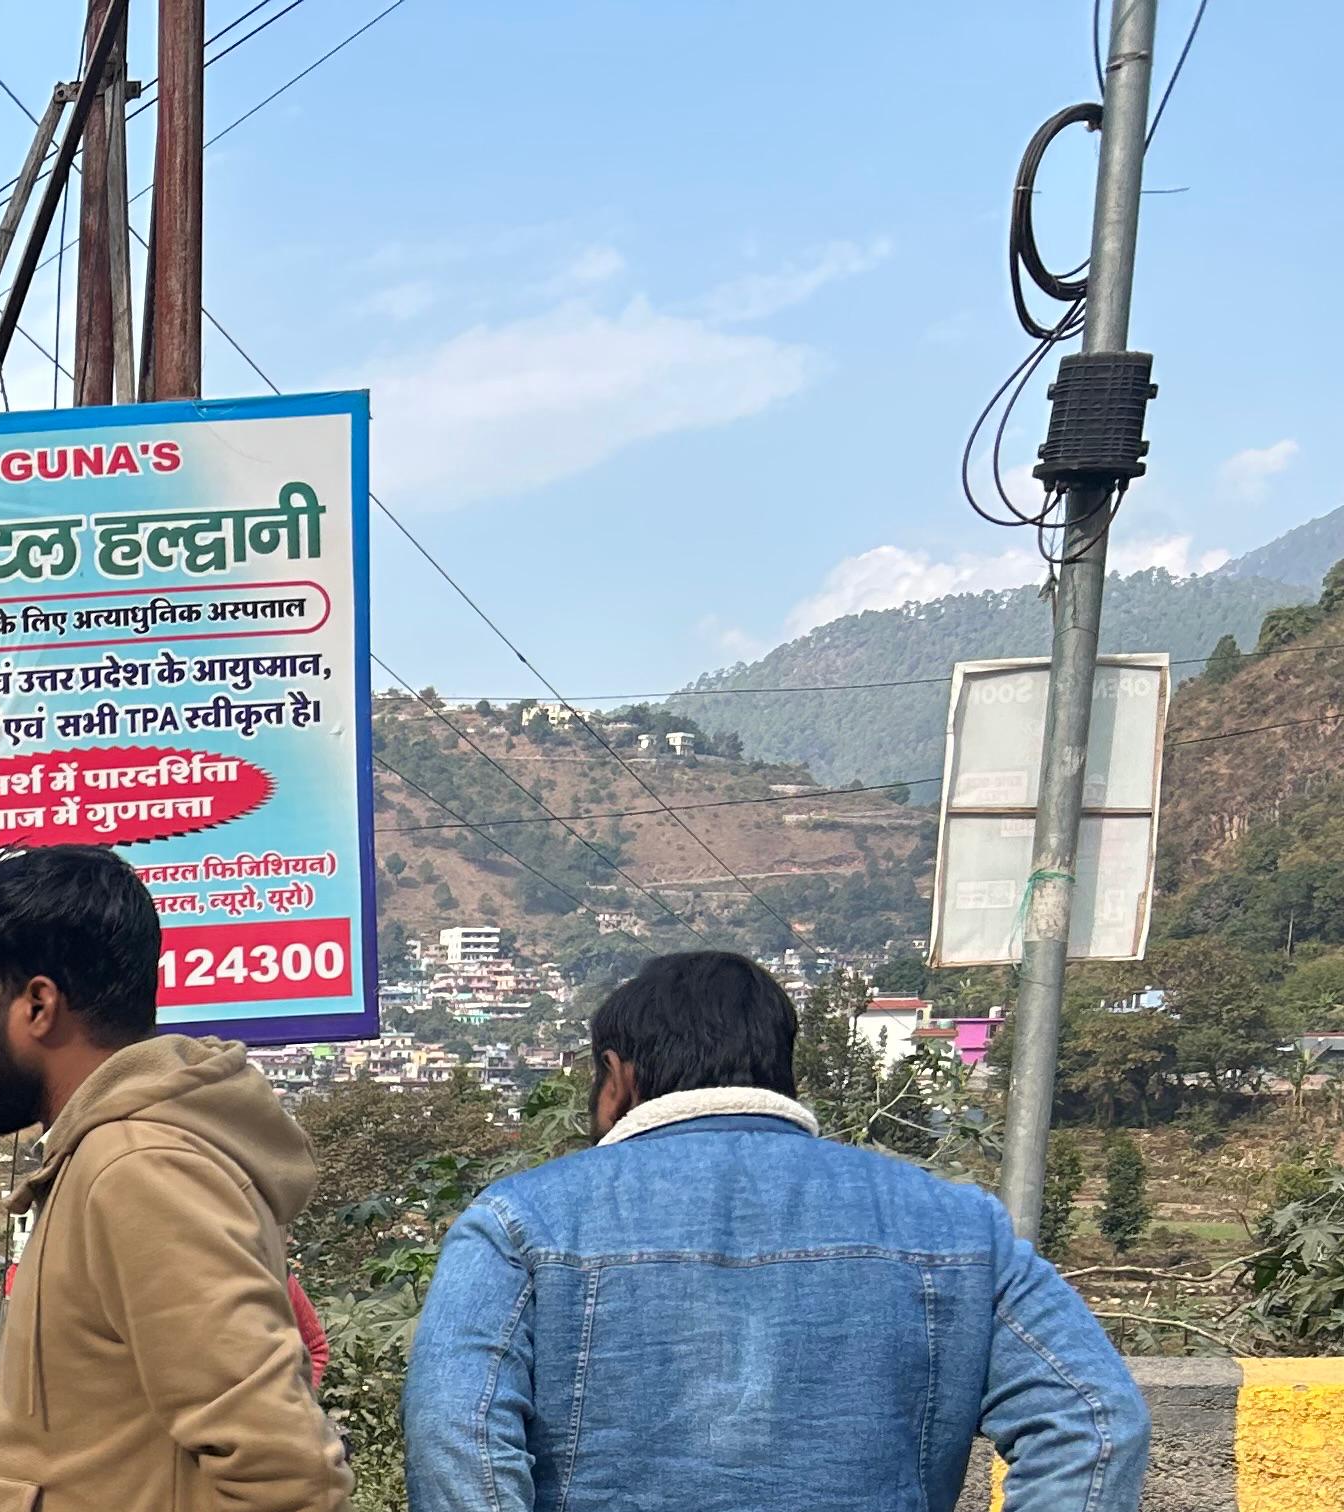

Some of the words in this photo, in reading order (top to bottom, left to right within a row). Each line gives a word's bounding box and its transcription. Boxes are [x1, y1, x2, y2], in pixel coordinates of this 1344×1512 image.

[94, 481, 327, 576] हल्द्वानी
[21, 605, 68, 636] लिए
[73, 597, 203, 634] अत्याधुनिक
[208, 598, 307, 621] अस्पताल
[17, 666, 75, 694] उत्तर
[79, 655, 151, 691] प्रदेश
[155, 652, 187, 684] के
[192, 653, 332, 691] आयुष्मान,
[3, 706, 45, 747] एवं
[56, 703, 119, 737] सभी
[125, 706, 179, 735] TPA
[184, 695, 286, 737] स्वीकृत
[49, 761, 80, 792] में
[82, 754, 241, 790] पारदर्शिता
[51, 796, 82, 827] में
[85, 796, 215, 833] गुणवत्ता
[203, 852, 337, 880] फिजिशियन)
[158, 941, 345, 988] 124300
